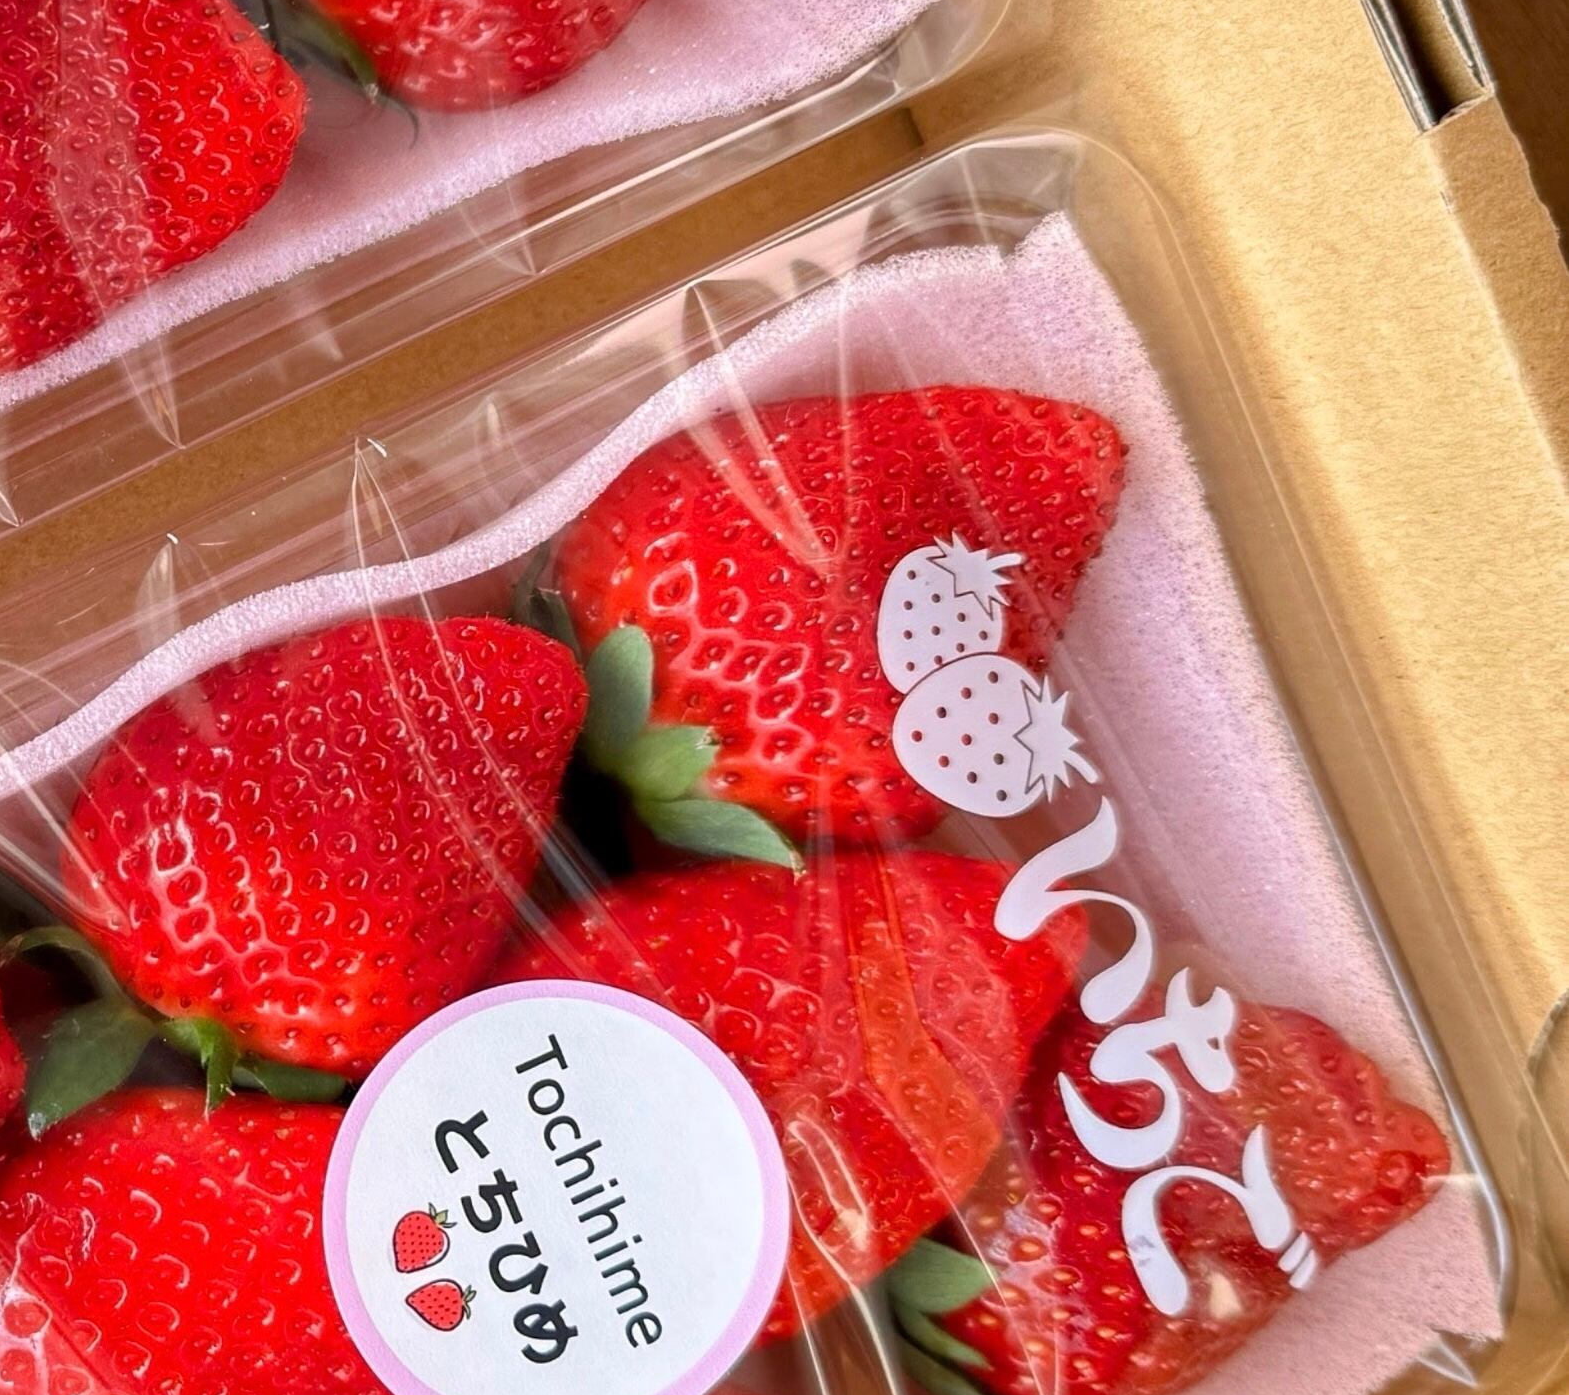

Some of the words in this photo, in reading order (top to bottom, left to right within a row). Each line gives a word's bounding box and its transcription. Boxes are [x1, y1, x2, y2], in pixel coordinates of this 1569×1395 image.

[515, 1033, 663, 1348] Tochihime
[993, 795, 1319, 1318] いちご
[434, 1110, 579, 1364] とちひめ
